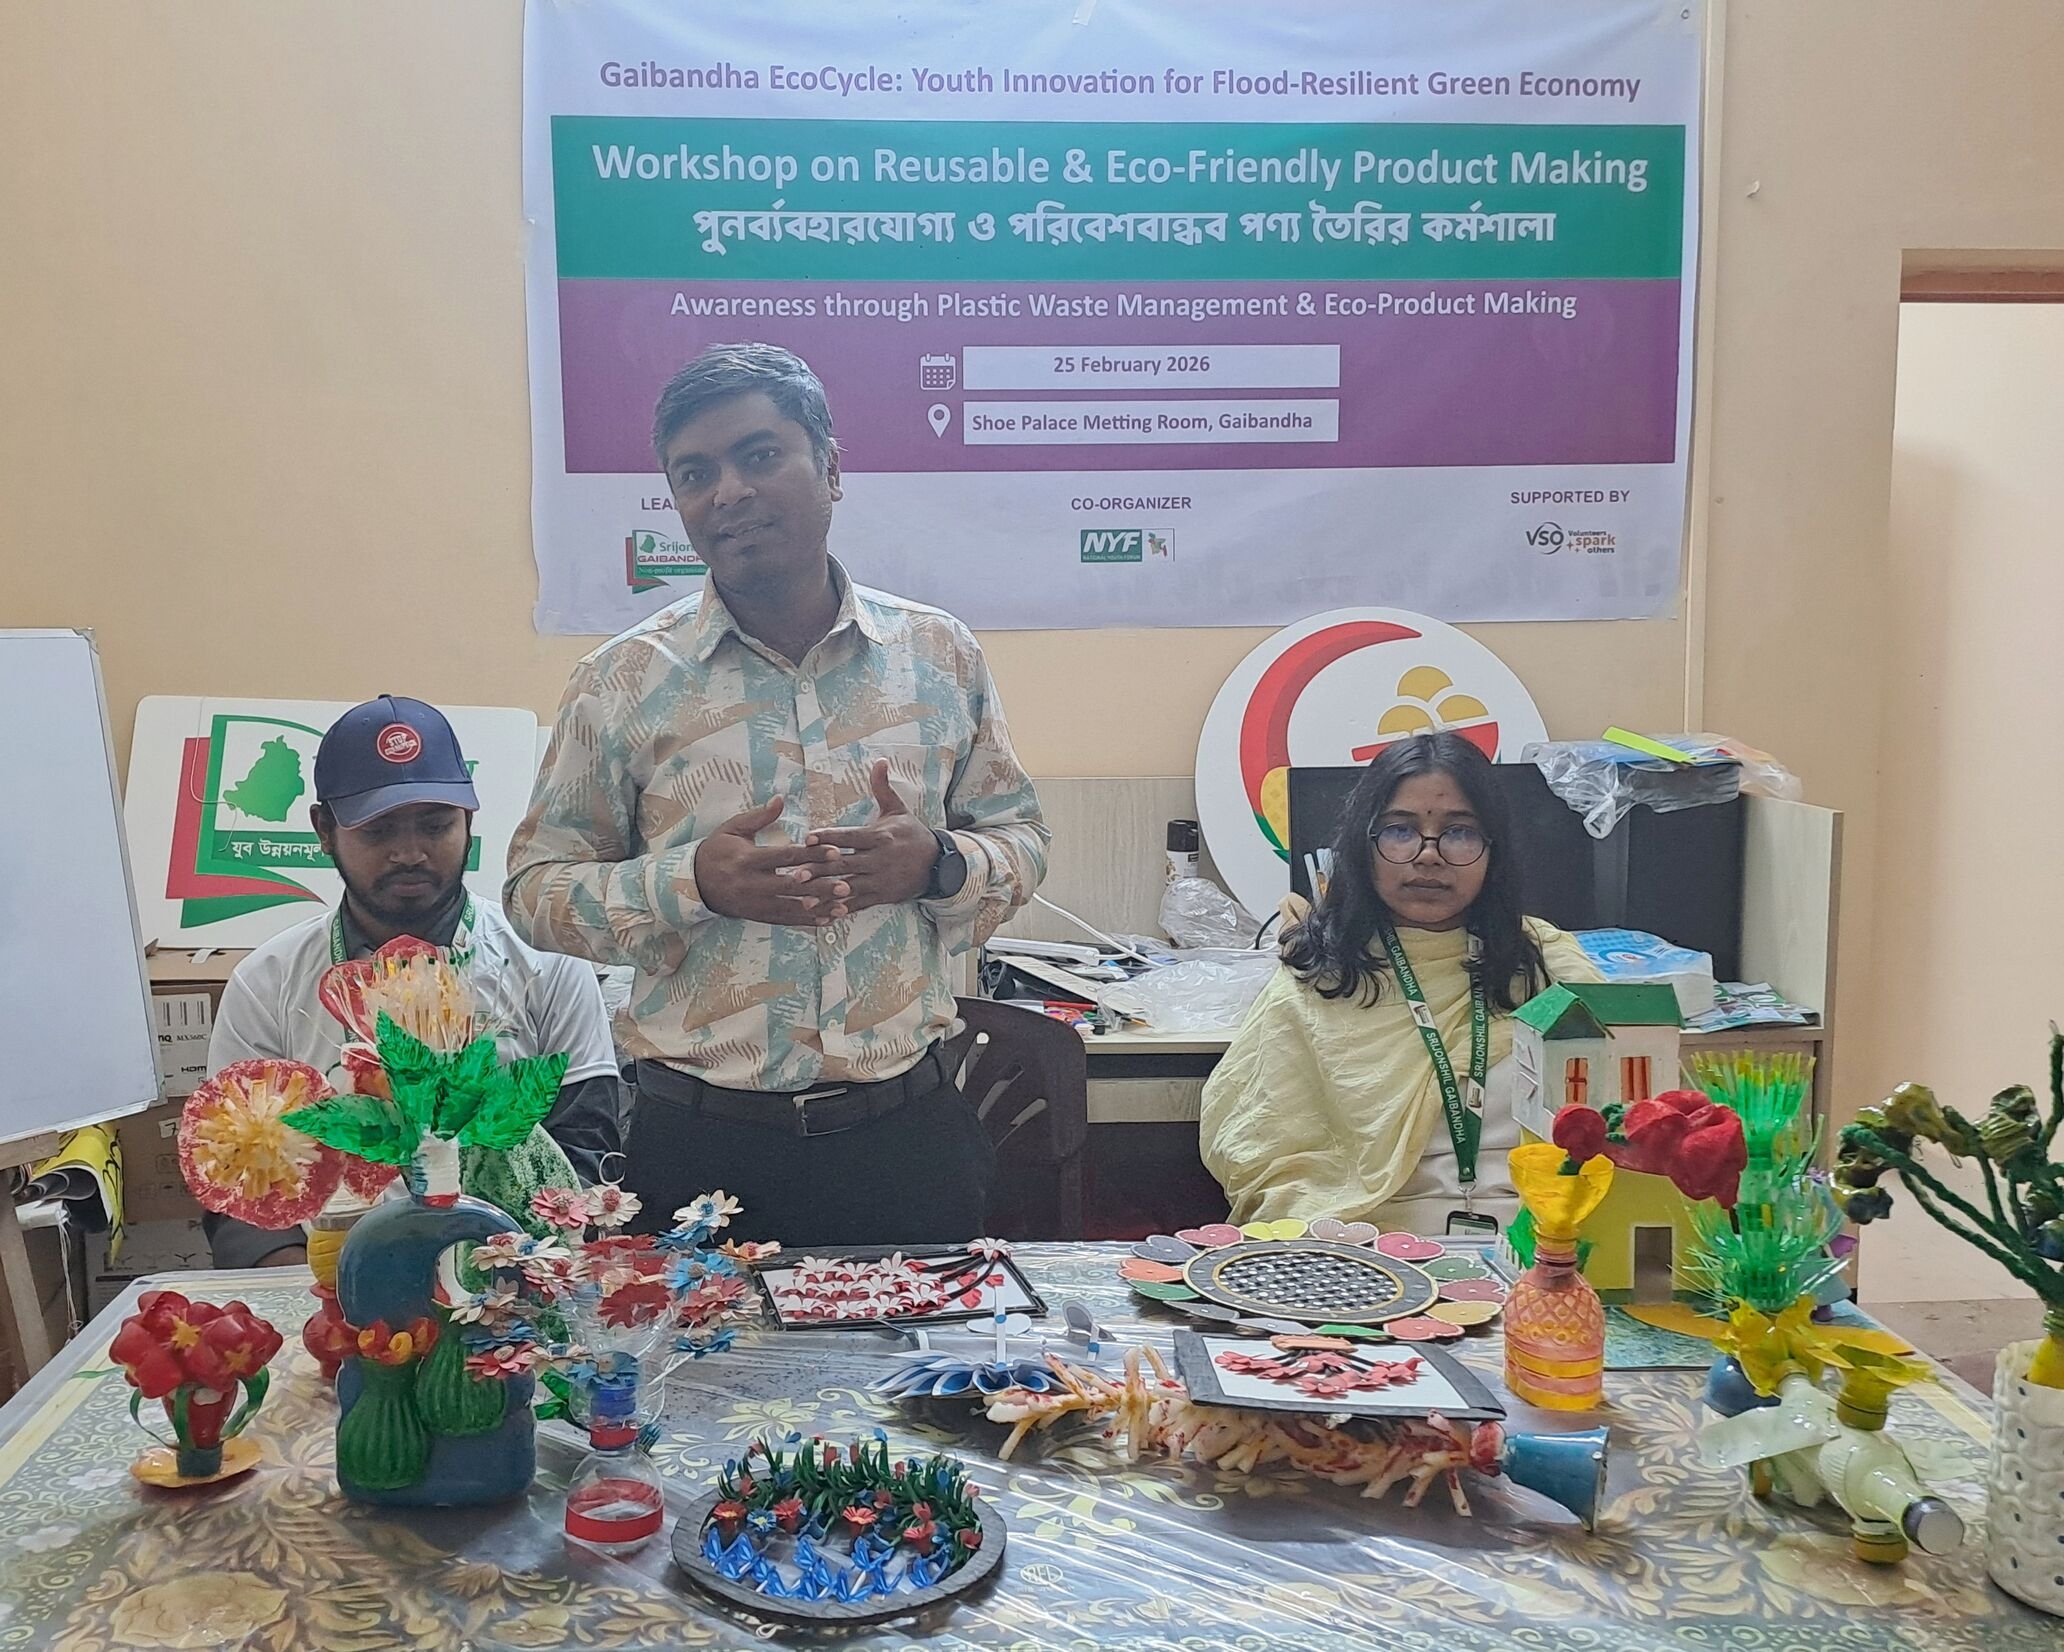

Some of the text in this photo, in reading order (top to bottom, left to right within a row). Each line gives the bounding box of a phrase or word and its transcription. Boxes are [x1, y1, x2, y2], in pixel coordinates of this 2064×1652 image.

[600, 60, 1642, 104] Gaibandha EcoCycle: Youth Innovation for Flood-Resilient Green Economy
[592, 144, 1649, 193] Workshop on Reusable & Eco-Friendly Product Making
[692, 198, 1557, 256] পুনর্ব্যবহারযোগ্য ও পরিবেশবান্ধব পণ্য তৈরির কর্মশালা
[671, 290, 1578, 322] Awareness through Plastic Waste Management & Eco-Product Making
[1053, 355, 1211, 377] 25 February 2026
[972, 412, 1313, 435] Shoe Palace Metting Room, Gaibandha
[641, 497, 677, 511] LEA
[1071, 496, 1192, 511] CO-ORGANIZER
[1510, 490, 1630, 504] SUPPORTED BY
[1083, 531, 1141, 553] NYF
[1525, 527, 1564, 548] VSO
[1575, 534, 1616, 549] spark
[637, 555, 703, 563] GAIBANDH
[1587, 546, 1615, 554] others
[230, 838, 324, 862] যুব উন্নয়নমূল
[332, 918, 344, 963] GAIBANDH
[1391, 945, 1418, 997] GAIBANDHA
[158, 1034, 174, 1043] nQ
[1474, 1023, 1485, 1078] SRIJONSHIL
[181, 1065, 208, 1073] HDM
[1426, 1032, 1467, 1144] SRIJONSHIL GAIBANDHA
